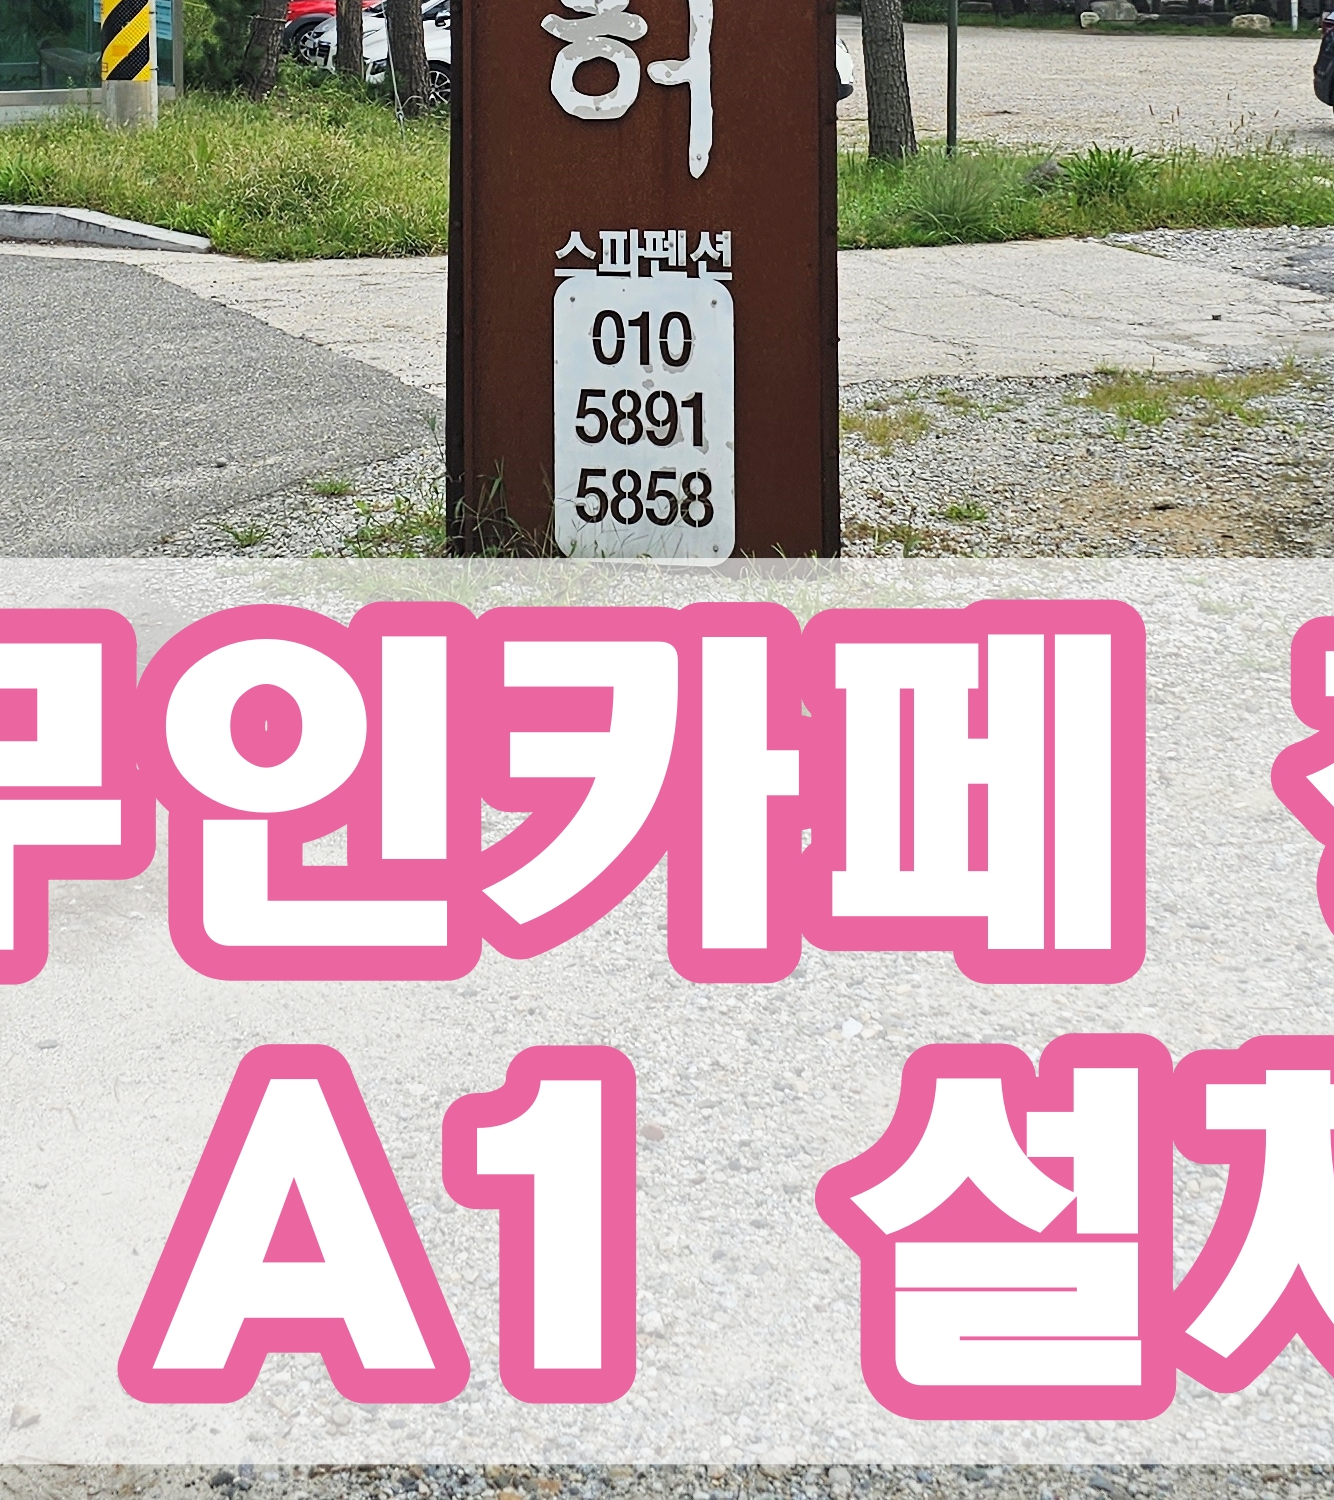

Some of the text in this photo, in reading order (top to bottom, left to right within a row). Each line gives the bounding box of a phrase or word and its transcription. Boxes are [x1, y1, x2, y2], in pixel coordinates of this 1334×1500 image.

[554, 228, 733, 280] 스파펜션
[590, 308, 694, 368] 010
[574, 388, 705, 448] 5891
[574, 468, 714, 528] 5858
